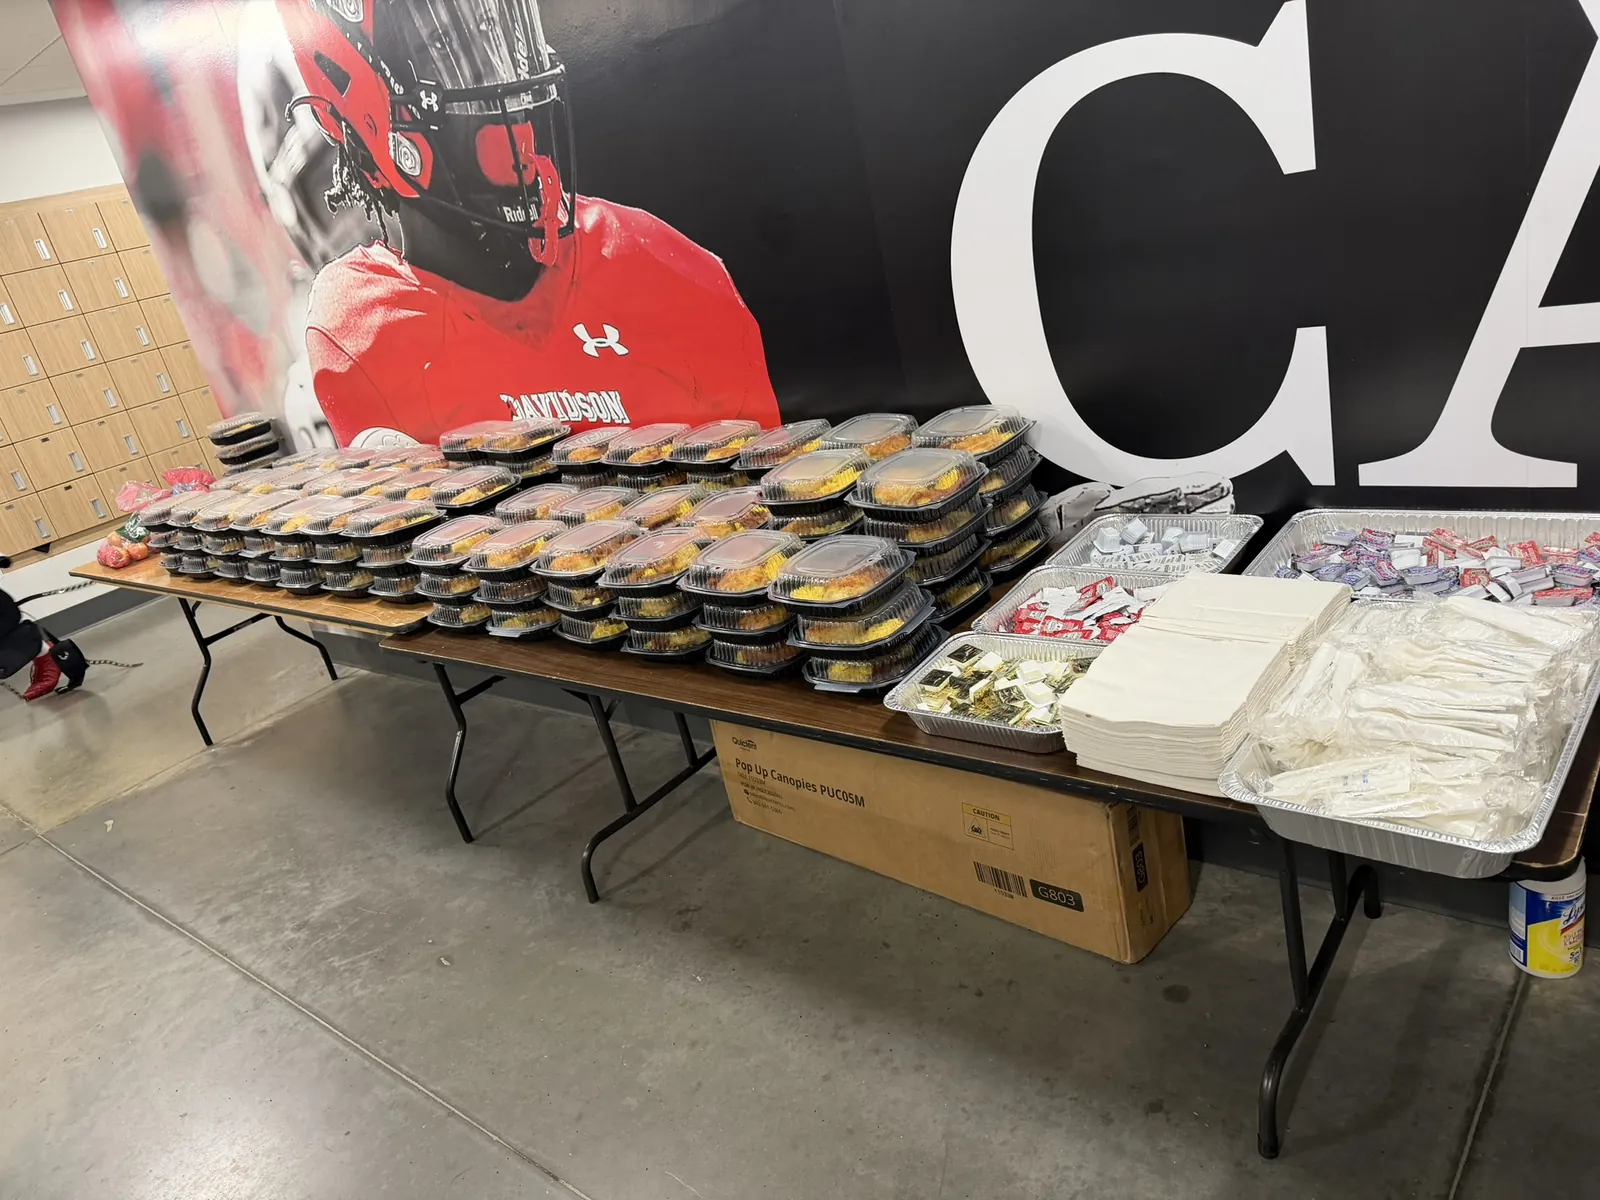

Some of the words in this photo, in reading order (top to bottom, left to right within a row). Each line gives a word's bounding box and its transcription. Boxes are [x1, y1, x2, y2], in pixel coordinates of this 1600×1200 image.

[500, 389, 631, 424] DAVIDSON
[735, 757, 753, 774] Pop
[755, 765, 769, 780] Up
[770, 769, 818, 793] Canopies
[819, 784, 866, 808] PUC05M
[972, 808, 1001, 821] CAUTION
[1037, 886, 1076, 906] G803
